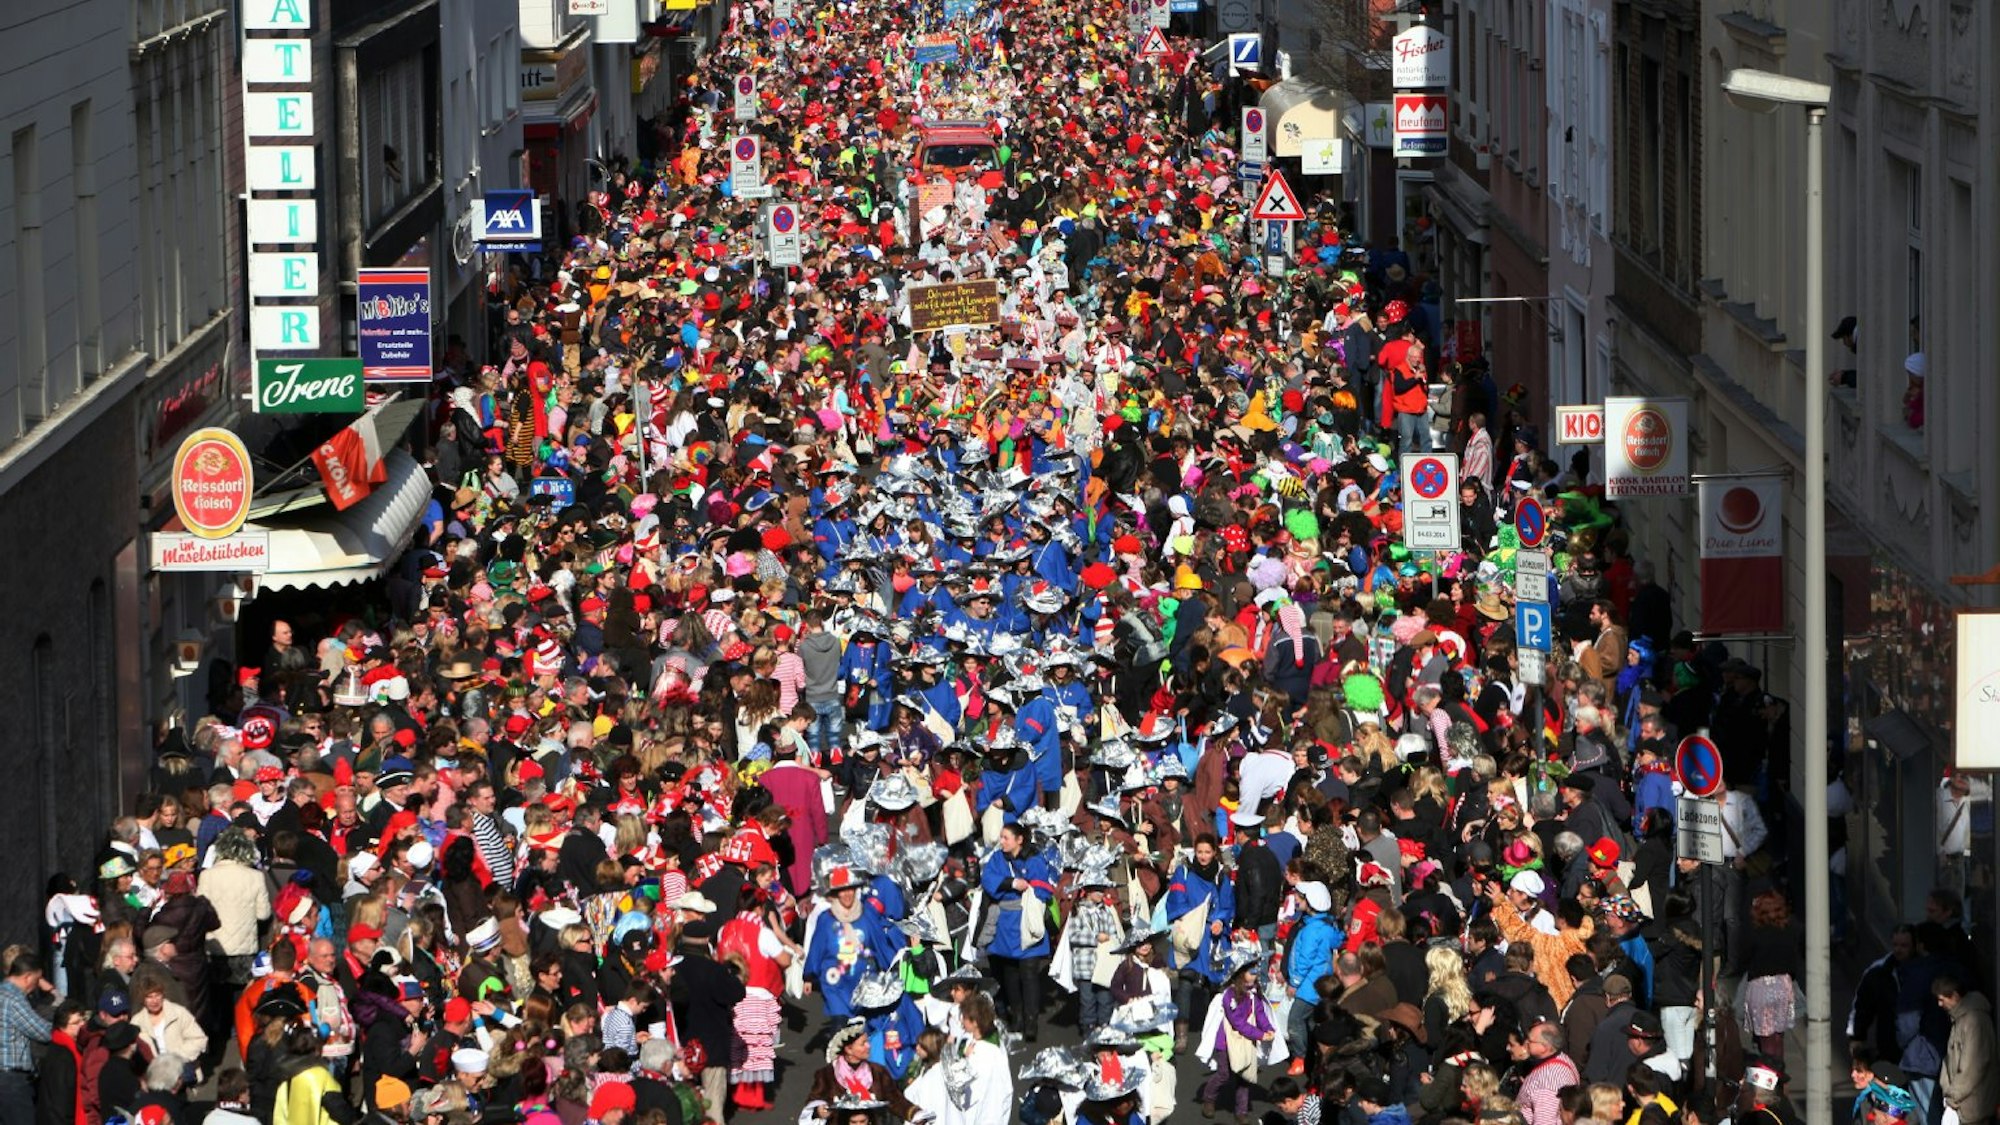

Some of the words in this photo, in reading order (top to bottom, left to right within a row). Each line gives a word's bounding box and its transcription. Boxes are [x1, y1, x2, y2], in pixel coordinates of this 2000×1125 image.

[1395, 36, 1445, 62] Fischer
[1400, 116, 1443, 127] neuform
[268, 0, 310, 343] ATELIER
[486, 210, 525, 229] AXA
[263, 364, 356, 408] Irene
[182, 478, 243, 493] Reissdorf
[325, 456, 356, 500] KÖLN
[1609, 477, 1639, 485] KIOSK
[1641, 476, 1686, 484] BABYLON
[1610, 484, 1686, 495] TRINKHALLE
[1523, 607, 1543, 646] P
[1680, 808, 1718, 825] Ladezone
